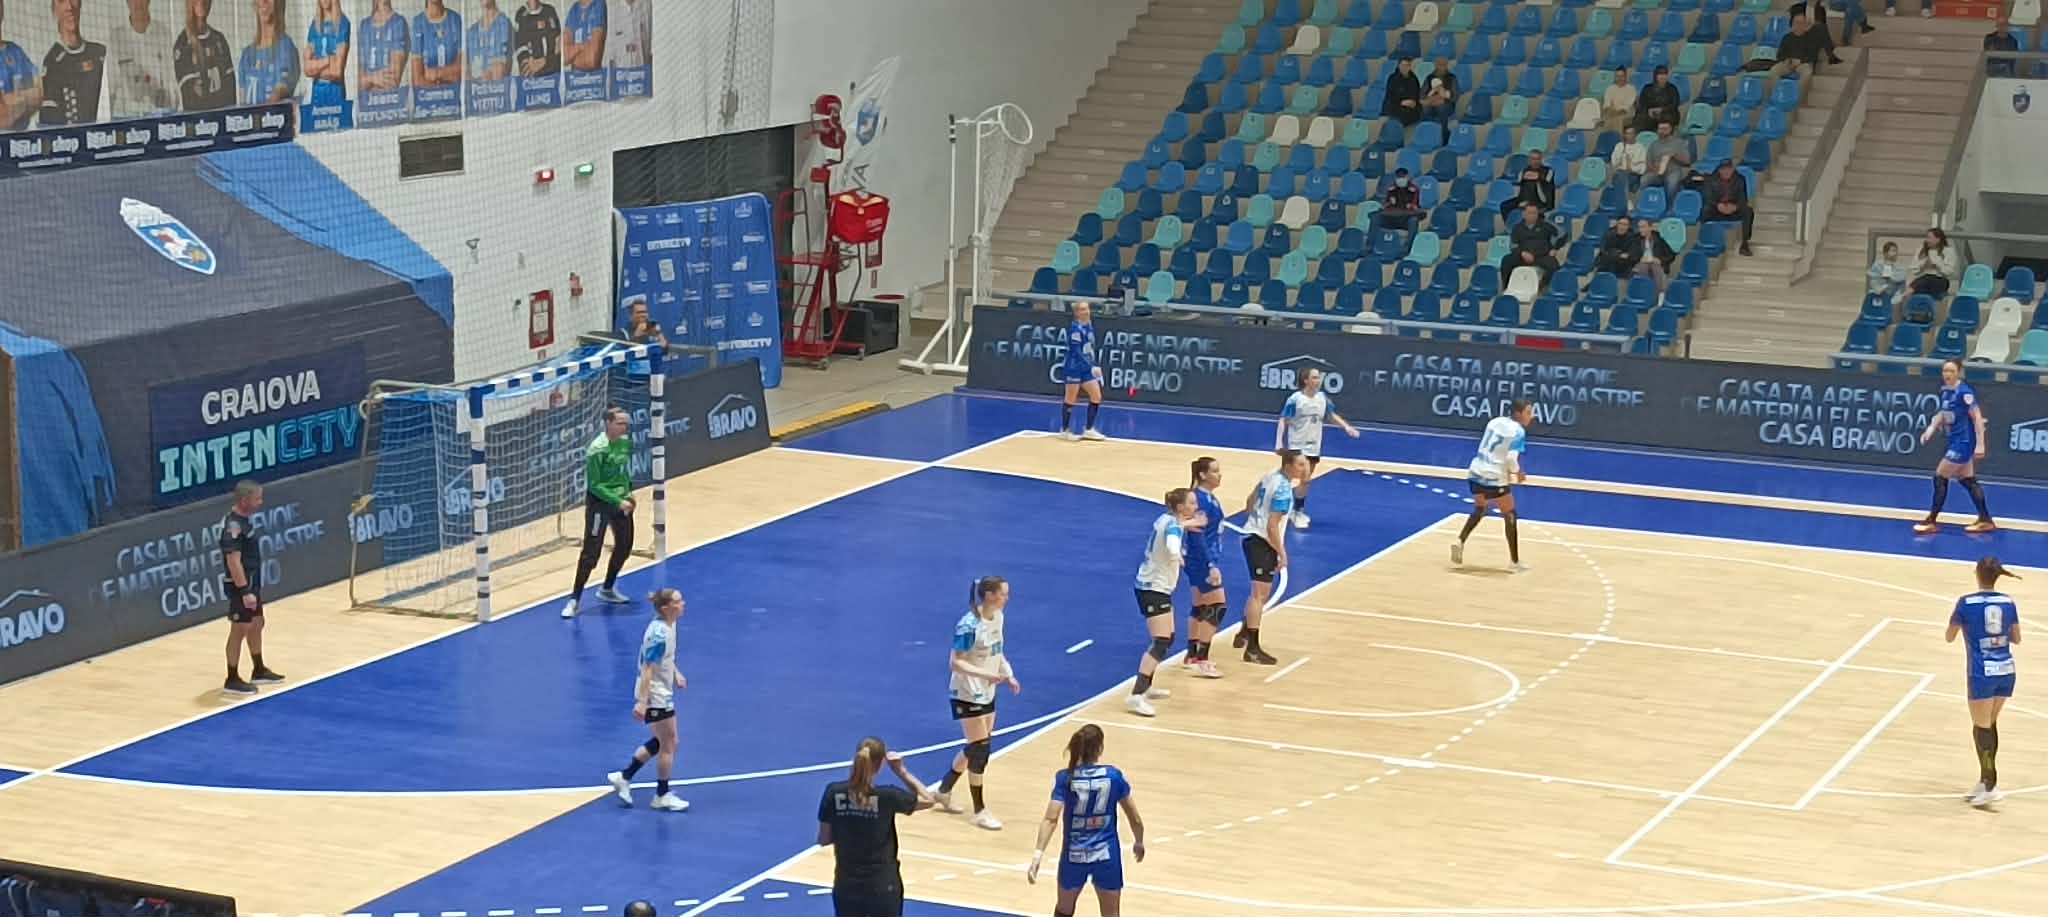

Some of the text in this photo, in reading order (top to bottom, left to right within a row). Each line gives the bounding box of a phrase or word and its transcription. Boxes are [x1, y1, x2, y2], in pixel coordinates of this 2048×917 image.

[201, 369, 321, 425] CRAIOVA
[1112, 368, 1182, 392] BRAVO
[1432, 393, 1492, 418] CASA
[159, 406, 361, 494] INTENCITY
[1759, 420, 1916, 455] CASA BRAVO
[161, 579, 217, 617] CASA
[1071, 777, 1112, 815] 77
